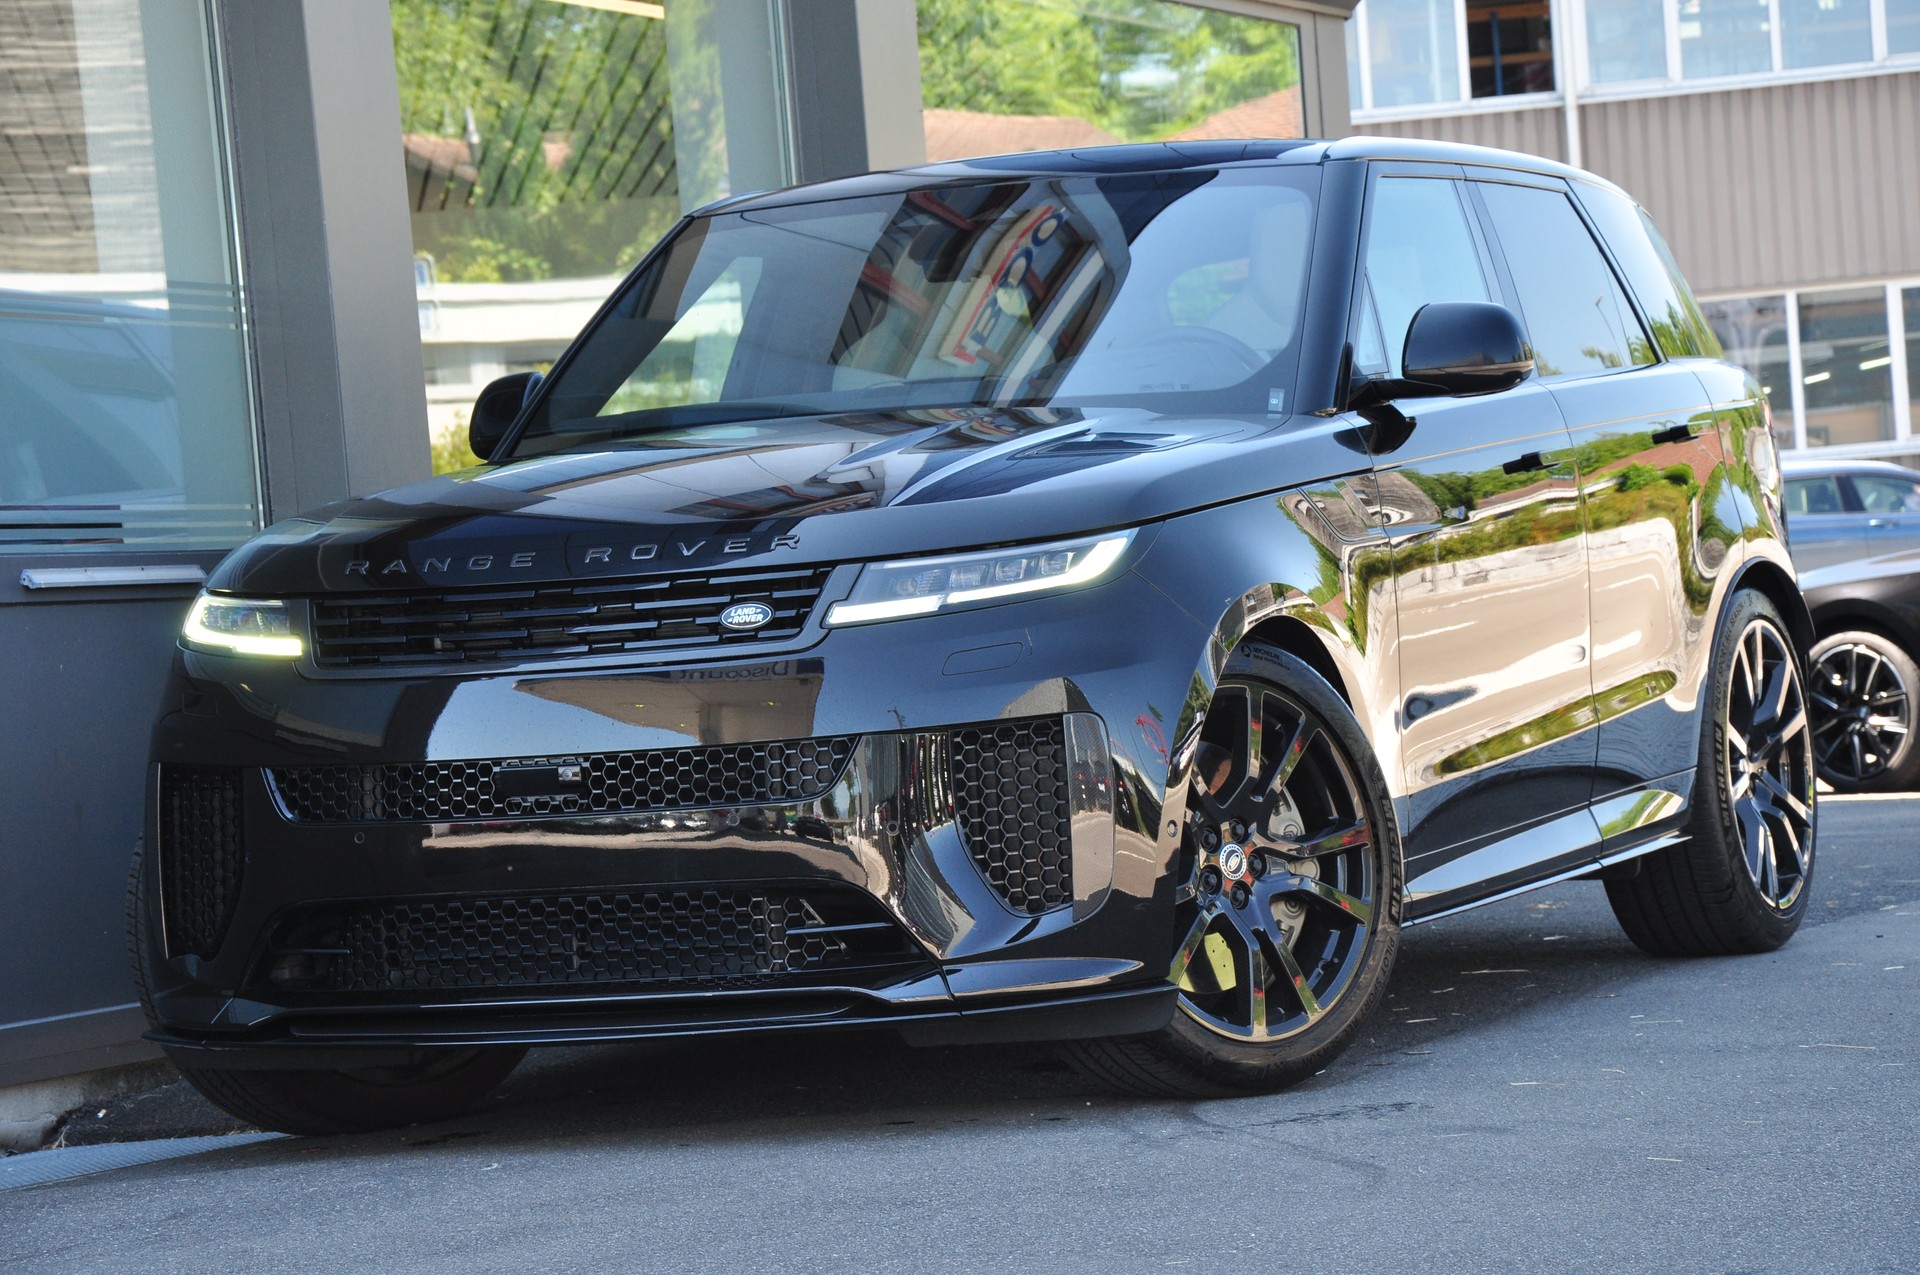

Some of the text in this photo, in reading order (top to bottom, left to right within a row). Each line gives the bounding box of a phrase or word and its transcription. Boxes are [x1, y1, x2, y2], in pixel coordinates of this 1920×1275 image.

[345, 534, 801, 575] RANGE ROVER
[730, 607, 756, 617] LAND
[732, 613, 764, 624] ROVER
[1252, 647, 1280, 661] MICHELIN
[1714, 726, 1731, 828] MICHELIN
[1381, 799, 1401, 920] MICHELIN
[1382, 937, 1395, 978] PILOT
[1361, 979, 1382, 1018] SPORT
